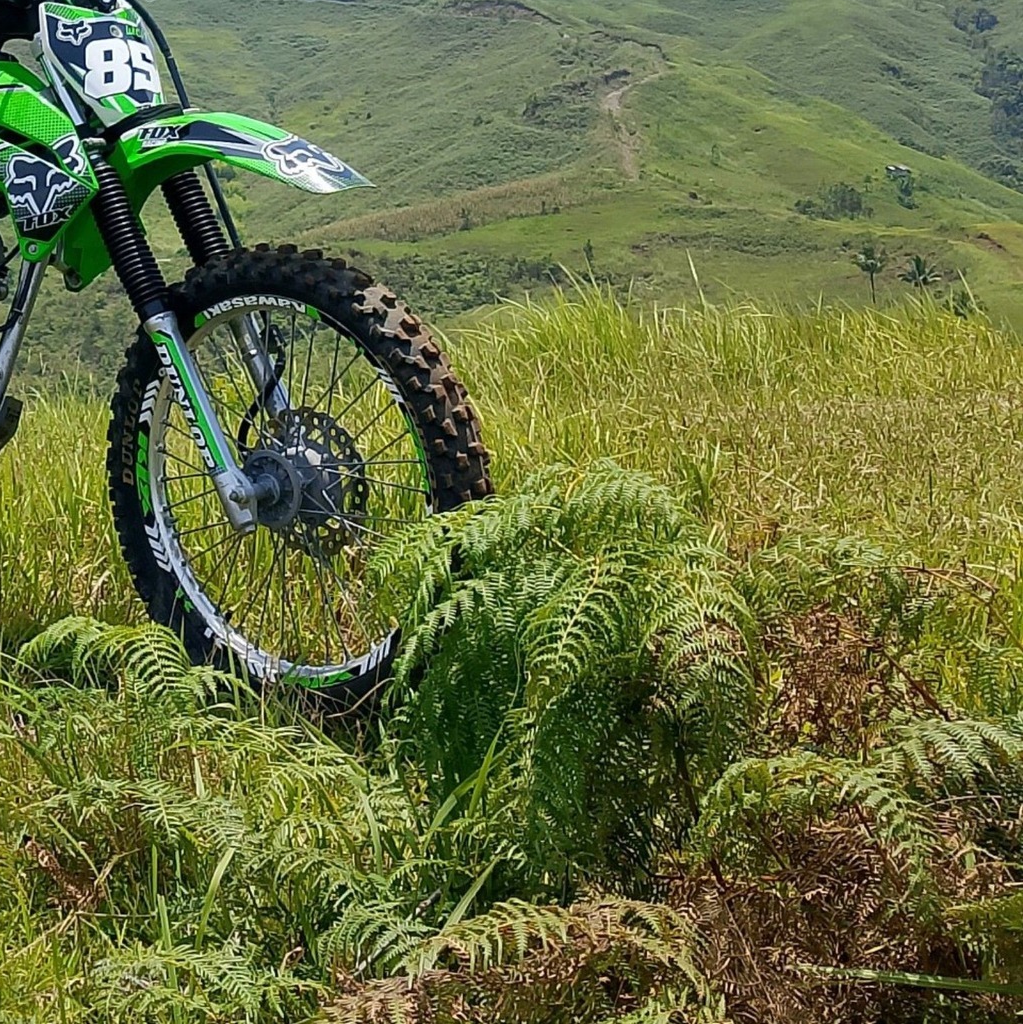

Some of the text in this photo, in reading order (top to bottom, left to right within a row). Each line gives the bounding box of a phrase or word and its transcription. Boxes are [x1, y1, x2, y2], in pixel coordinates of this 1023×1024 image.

[84, 38, 161, 99] 85
[138, 126, 184, 141] FOX
[202, 295, 306, 320] Kawasaki
[155, 342, 216, 468] DUNLOP
